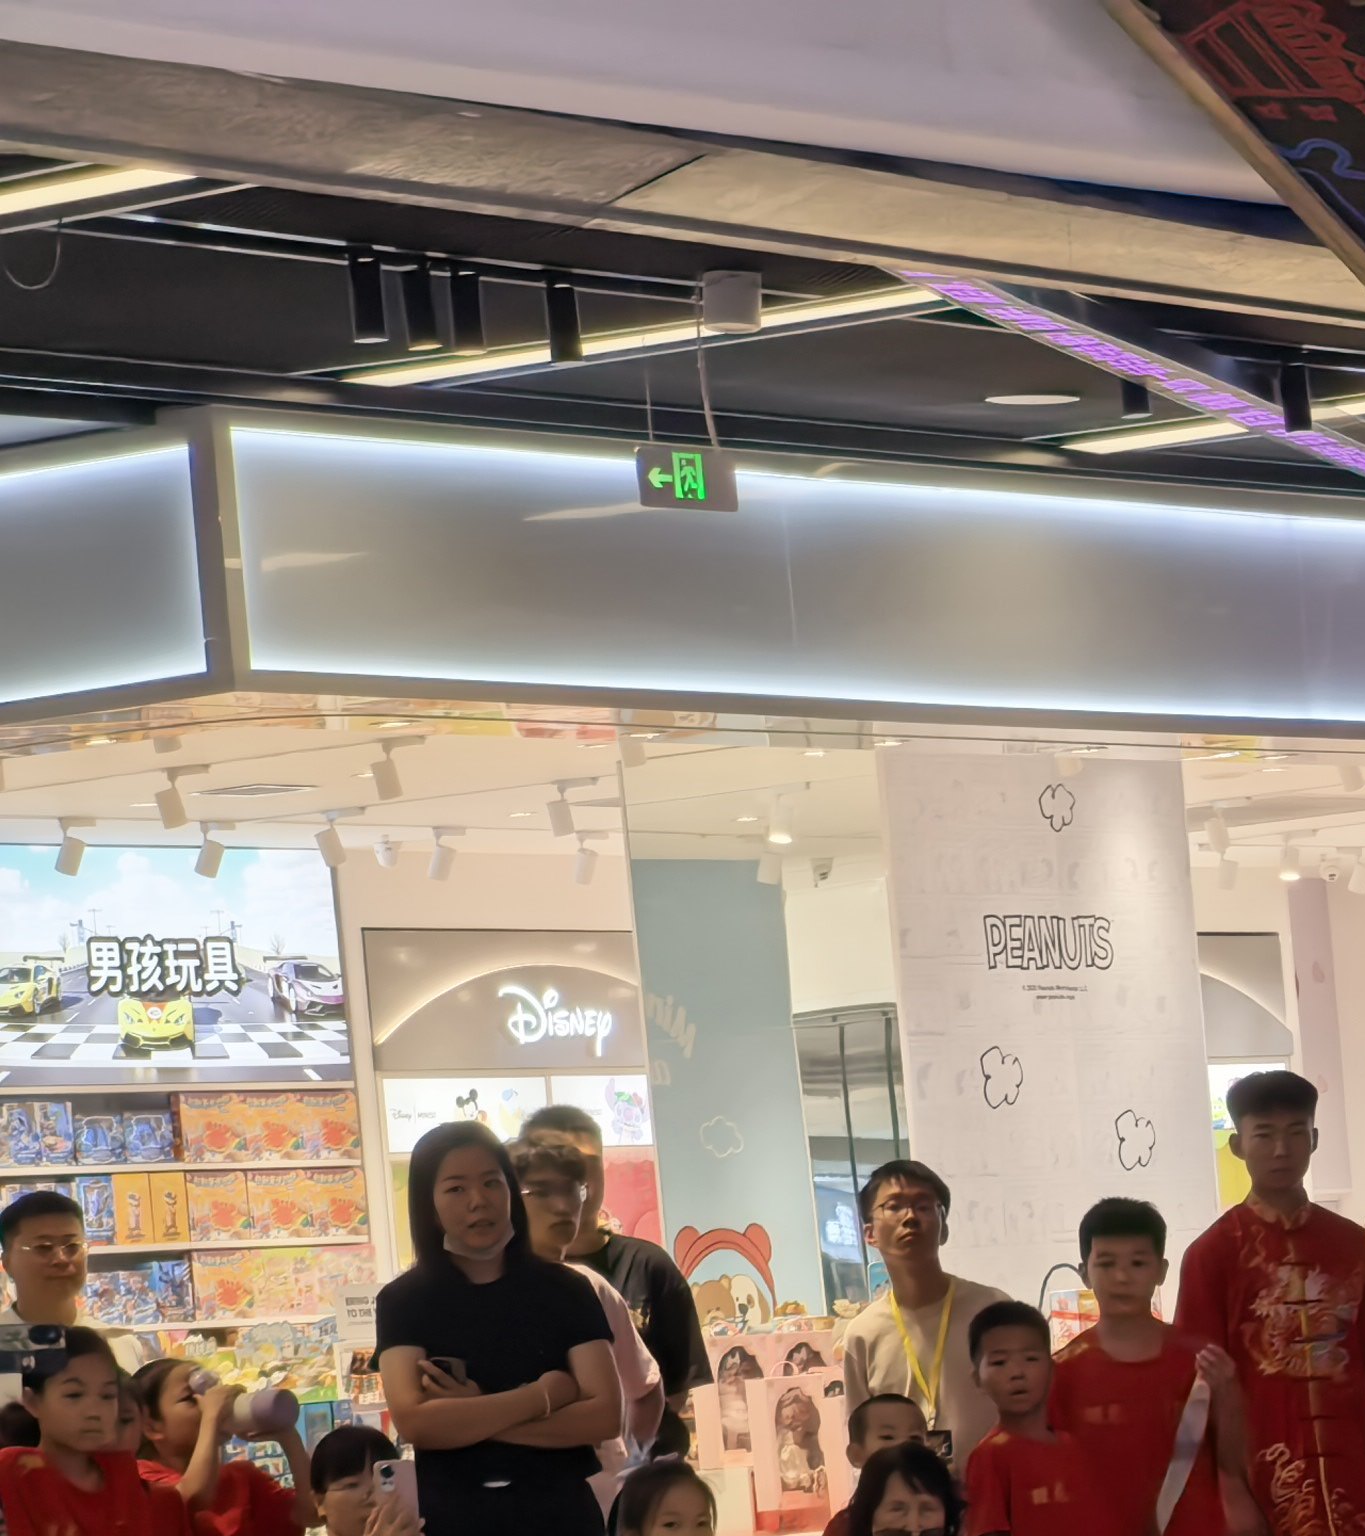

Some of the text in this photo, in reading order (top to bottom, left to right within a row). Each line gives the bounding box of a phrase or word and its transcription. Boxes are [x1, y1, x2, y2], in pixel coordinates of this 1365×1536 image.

[88, 938, 241, 996] 男孩玩具
[983, 914, 1114, 971] PEANUTS
